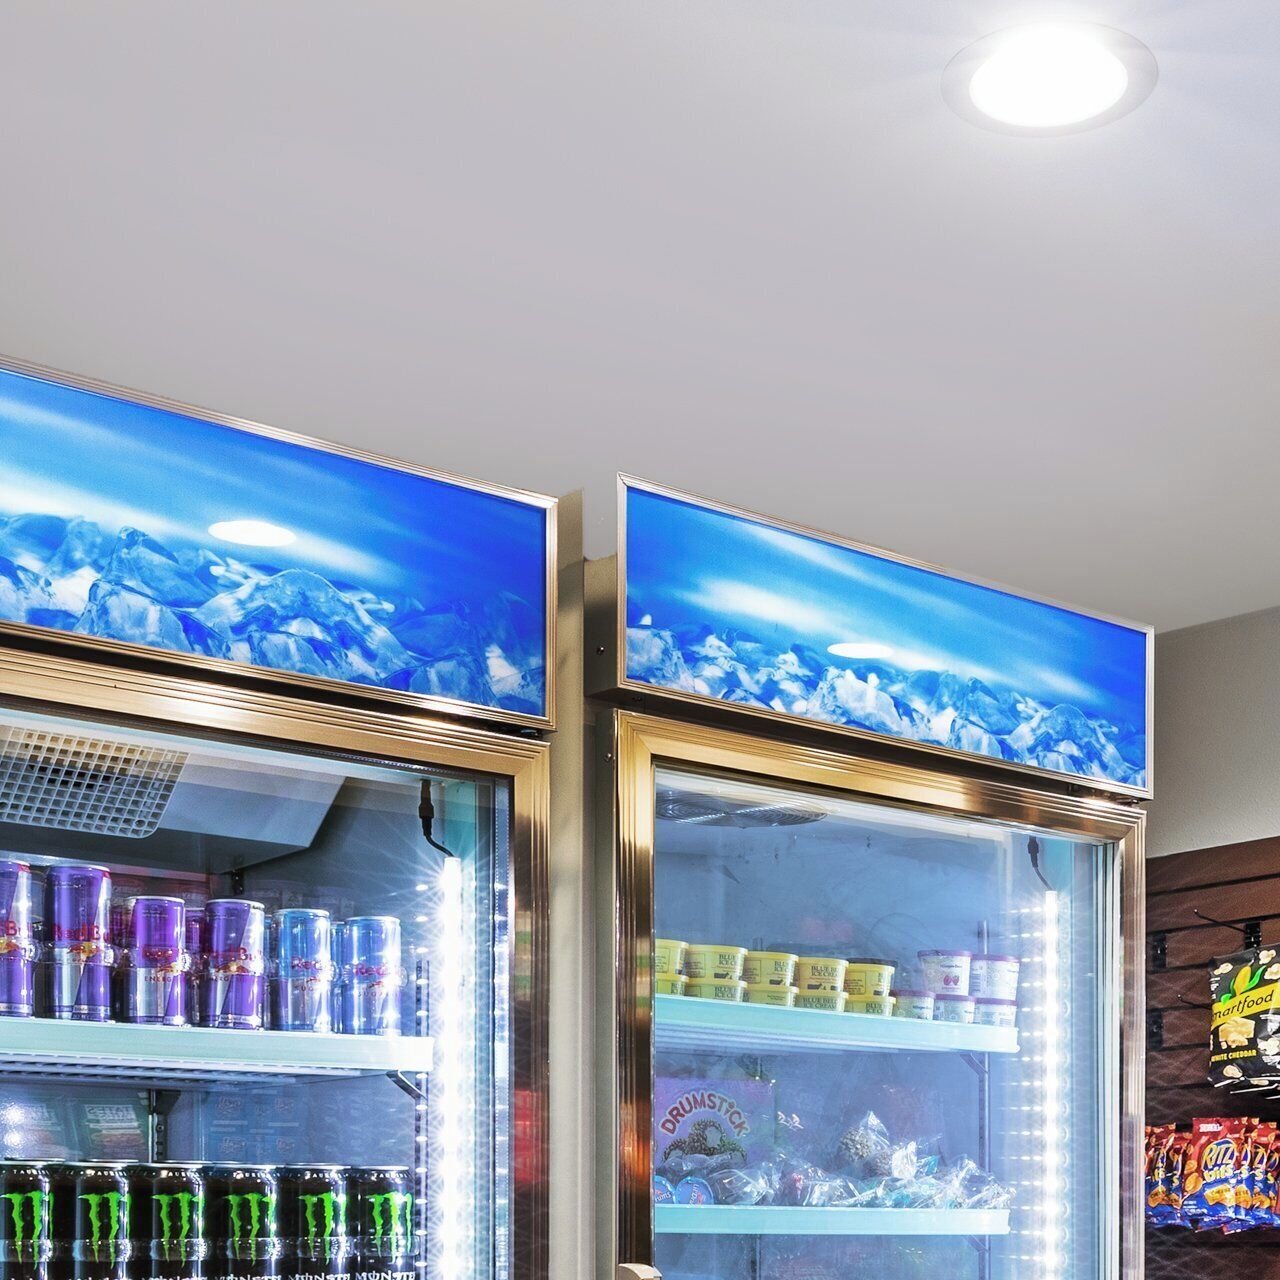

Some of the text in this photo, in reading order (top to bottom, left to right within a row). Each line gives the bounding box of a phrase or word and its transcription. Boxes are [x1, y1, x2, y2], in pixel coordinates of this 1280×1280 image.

[1228, 1049, 1257, 1061] CHEDDAR
[660, 1091, 749, 1138] DRUMSTICK
[1203, 1143, 1236, 1169] RITZ
